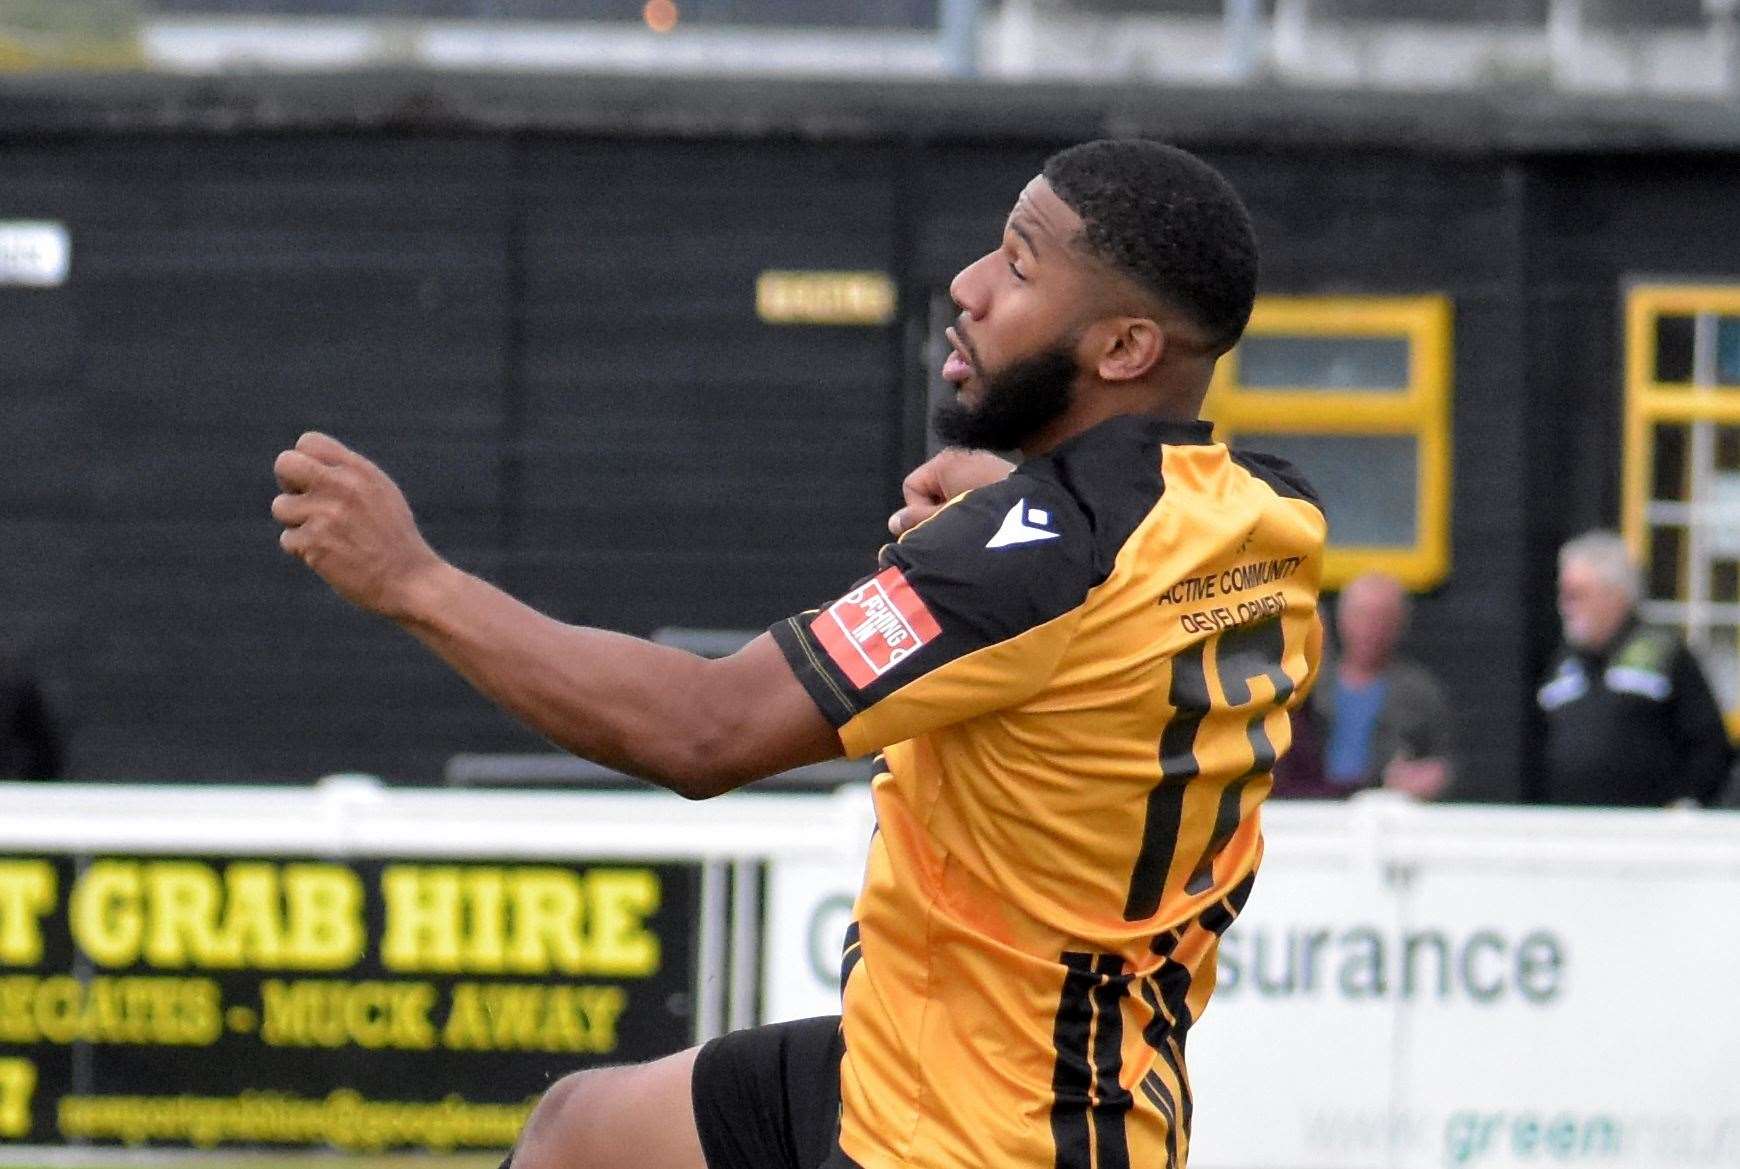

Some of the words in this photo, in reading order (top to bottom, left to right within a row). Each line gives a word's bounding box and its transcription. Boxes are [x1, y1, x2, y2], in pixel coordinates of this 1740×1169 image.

[1157, 574, 1217, 607] ACTIVE
[1219, 554, 1308, 596] COMMUNITY
[1180, 591, 1289, 635] DEVELOPMENT
[70, 862, 365, 971] GRAB
[379, 866, 662, 977] HIRE
[260, 979, 437, 1050] MUCK
[445, 984, 628, 1054] AWAY
